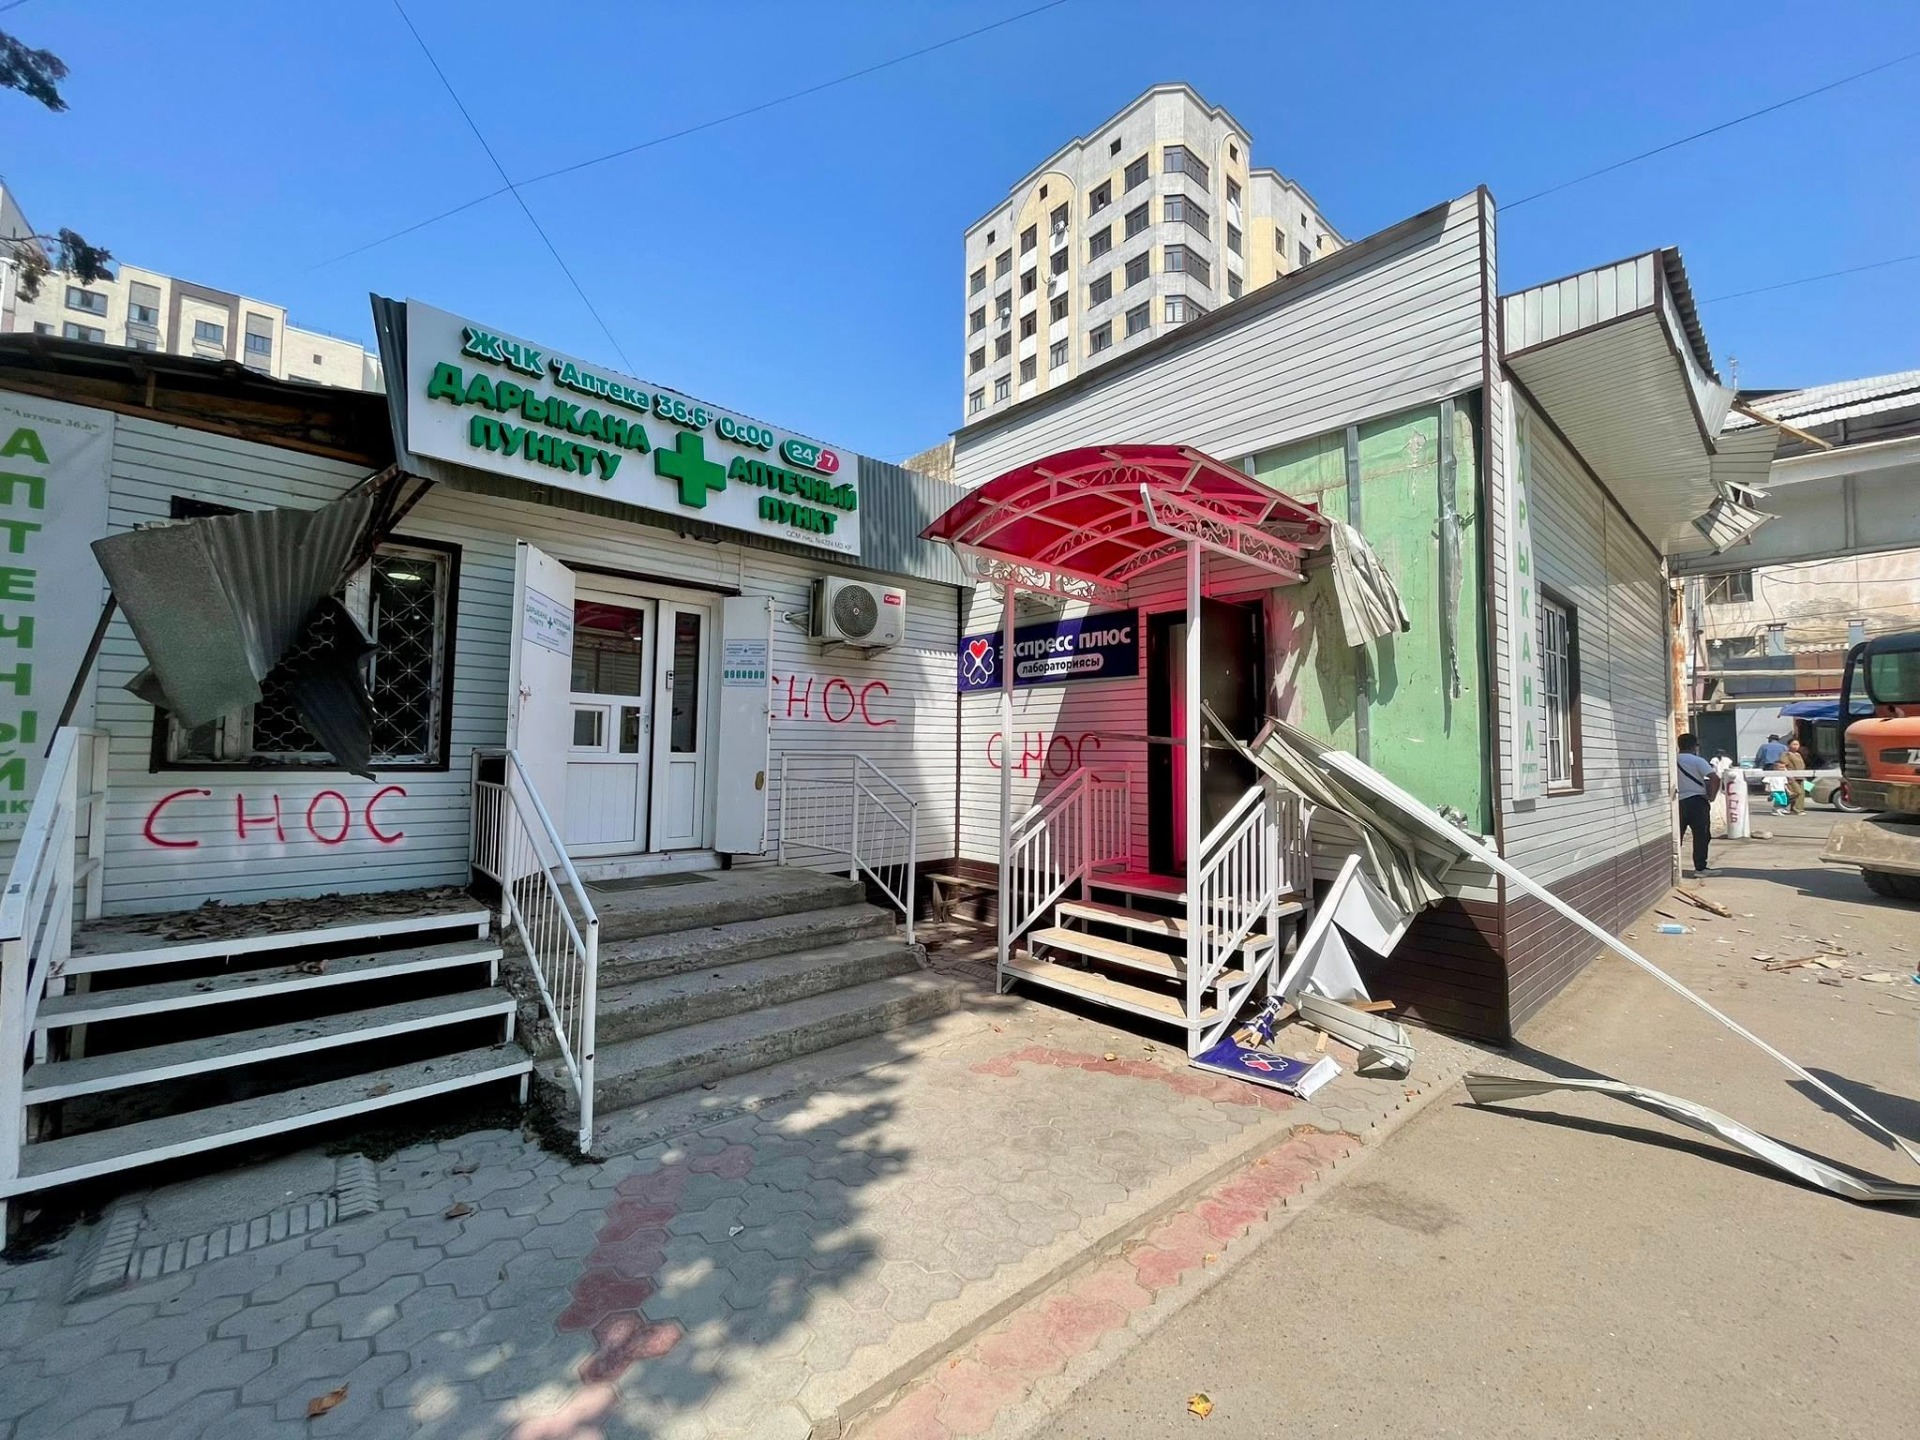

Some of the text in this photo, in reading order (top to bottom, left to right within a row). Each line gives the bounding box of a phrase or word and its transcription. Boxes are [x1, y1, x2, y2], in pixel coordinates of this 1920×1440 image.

[462, 327, 545, 378] ЖЧК
[550, 358, 650, 411] "Аптека
[653, 394, 713, 431] 36.6"
[428, 362, 651, 454] ДАРЫКАНА
[470, 415, 622, 480] ПУНКТУ
[728, 456, 857, 512] АПТЕЧНЫЙ
[759, 495, 838, 535] ПУНКТ
[1079, 626, 1132, 649] плюс
[1022, 657, 1101, 675] лабораториясы
[771, 675, 896, 727] НОС
[143, 785, 407, 848] СНОС
